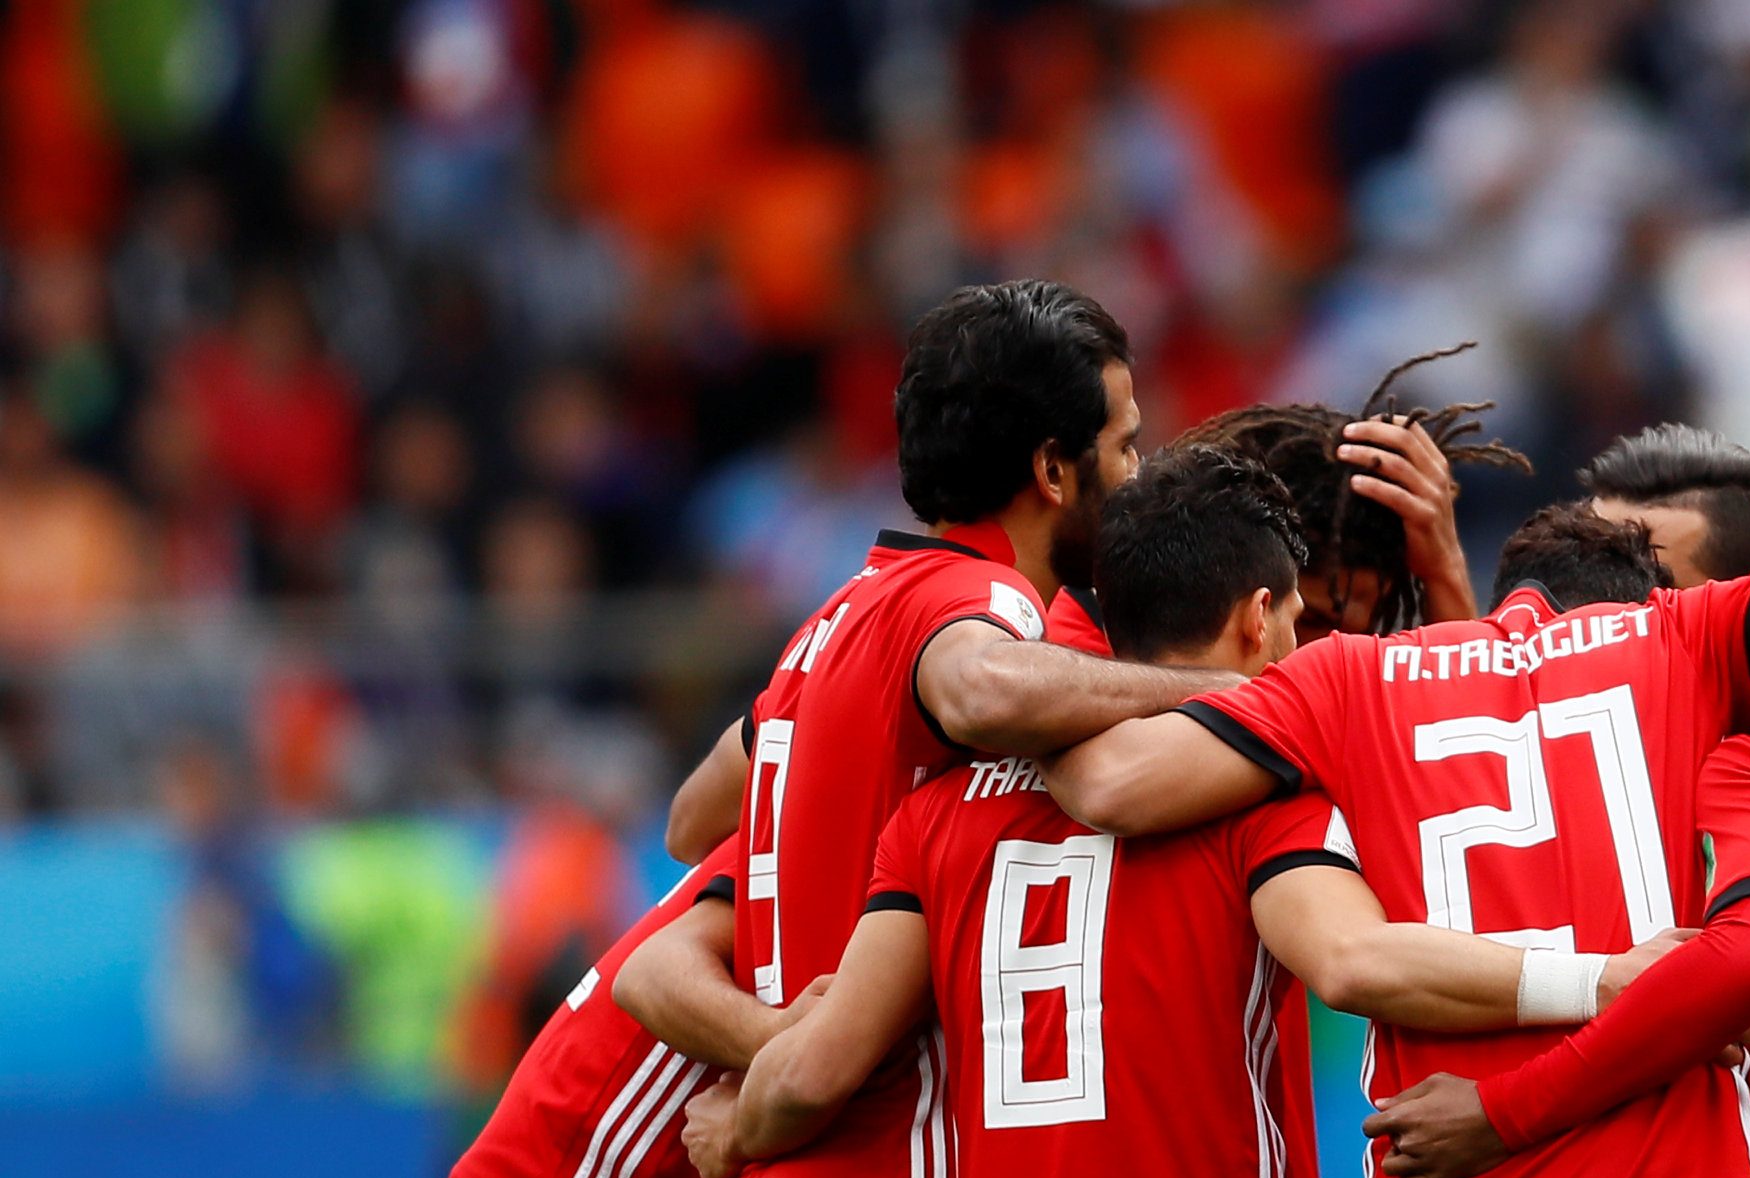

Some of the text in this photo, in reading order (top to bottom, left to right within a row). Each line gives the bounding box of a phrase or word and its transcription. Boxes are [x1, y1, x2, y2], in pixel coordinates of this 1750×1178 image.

[748, 718, 795, 1005] 9
[1414, 684, 1677, 955] 21
[980, 833, 1115, 1130] 8
